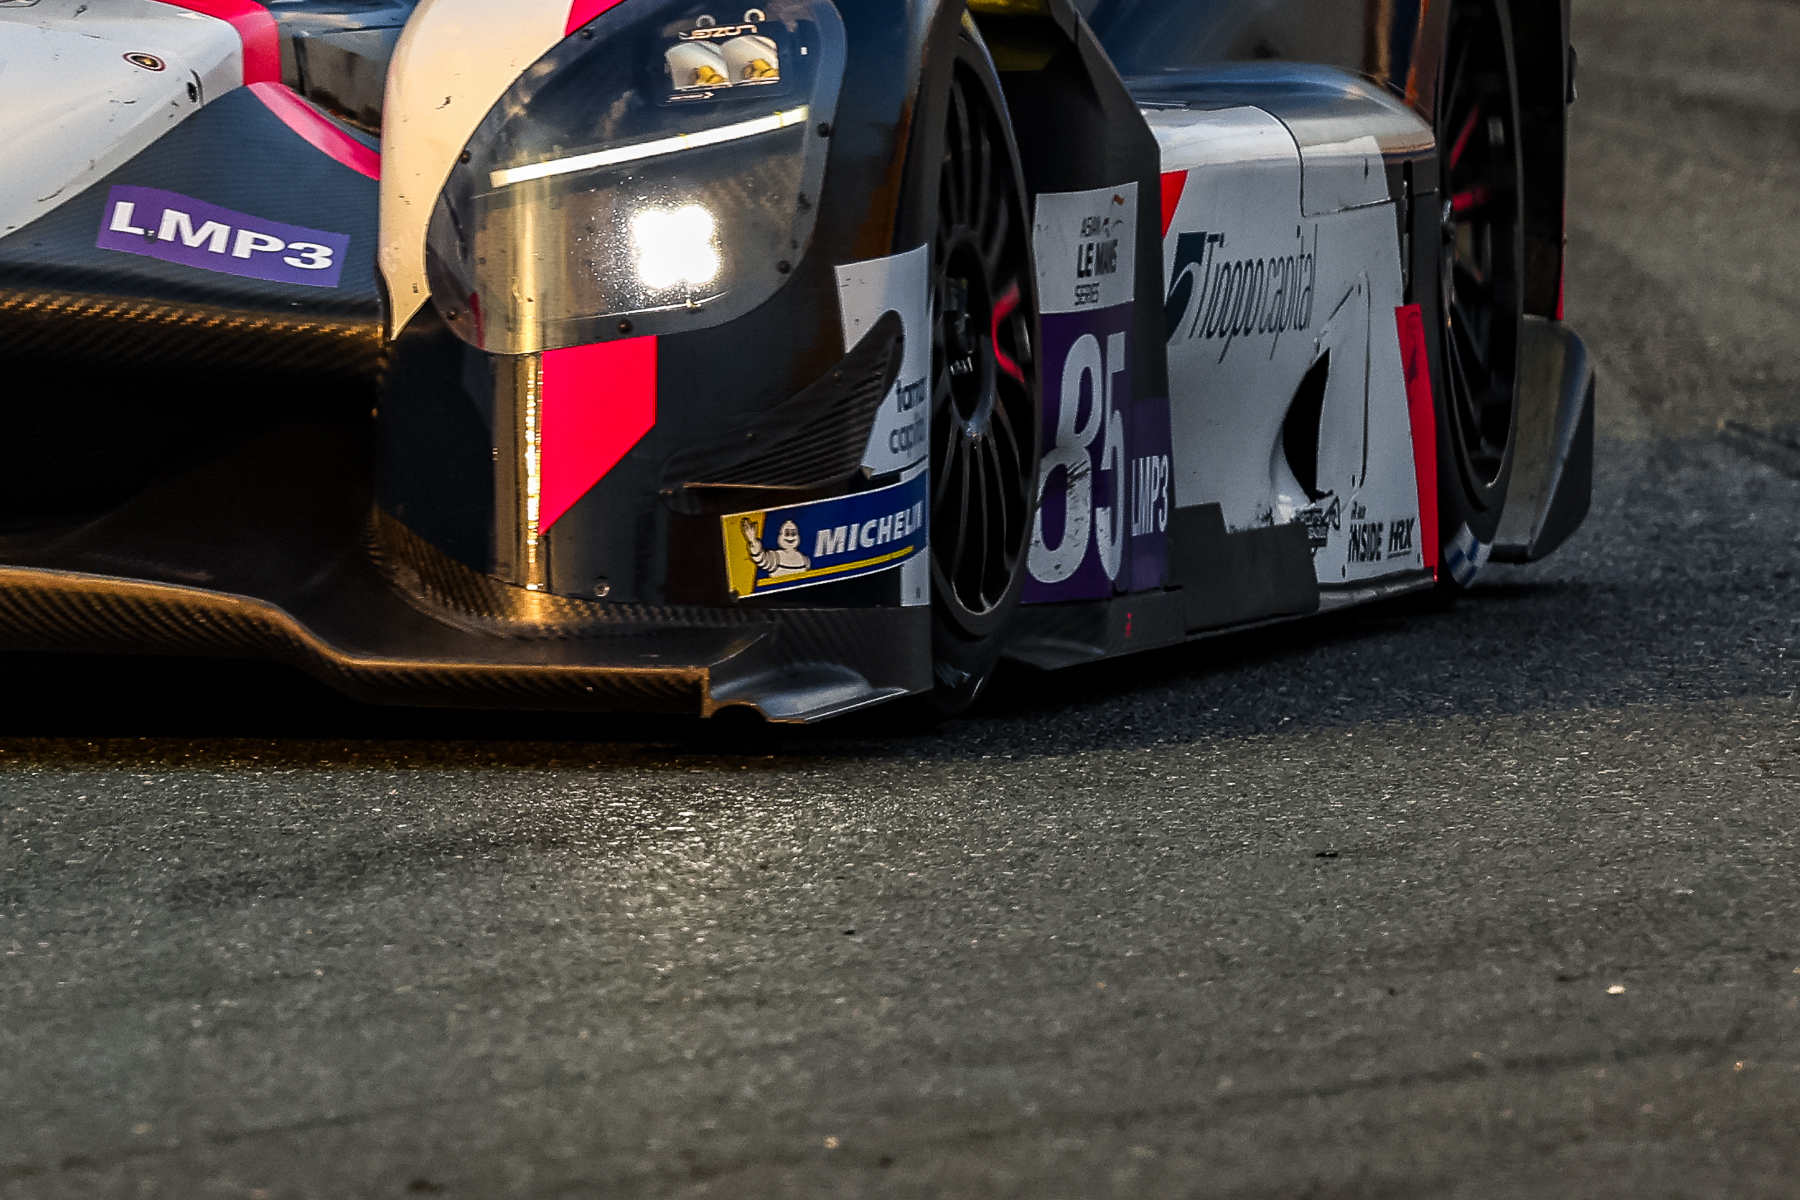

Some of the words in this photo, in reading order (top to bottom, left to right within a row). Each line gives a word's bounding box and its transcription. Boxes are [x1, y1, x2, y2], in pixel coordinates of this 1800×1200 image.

[109, 201, 334, 270] LMP3
[1077, 243, 1093, 278] LE
[1026, 331, 1126, 584] 85
[1131, 454, 1169, 537] LMP3
